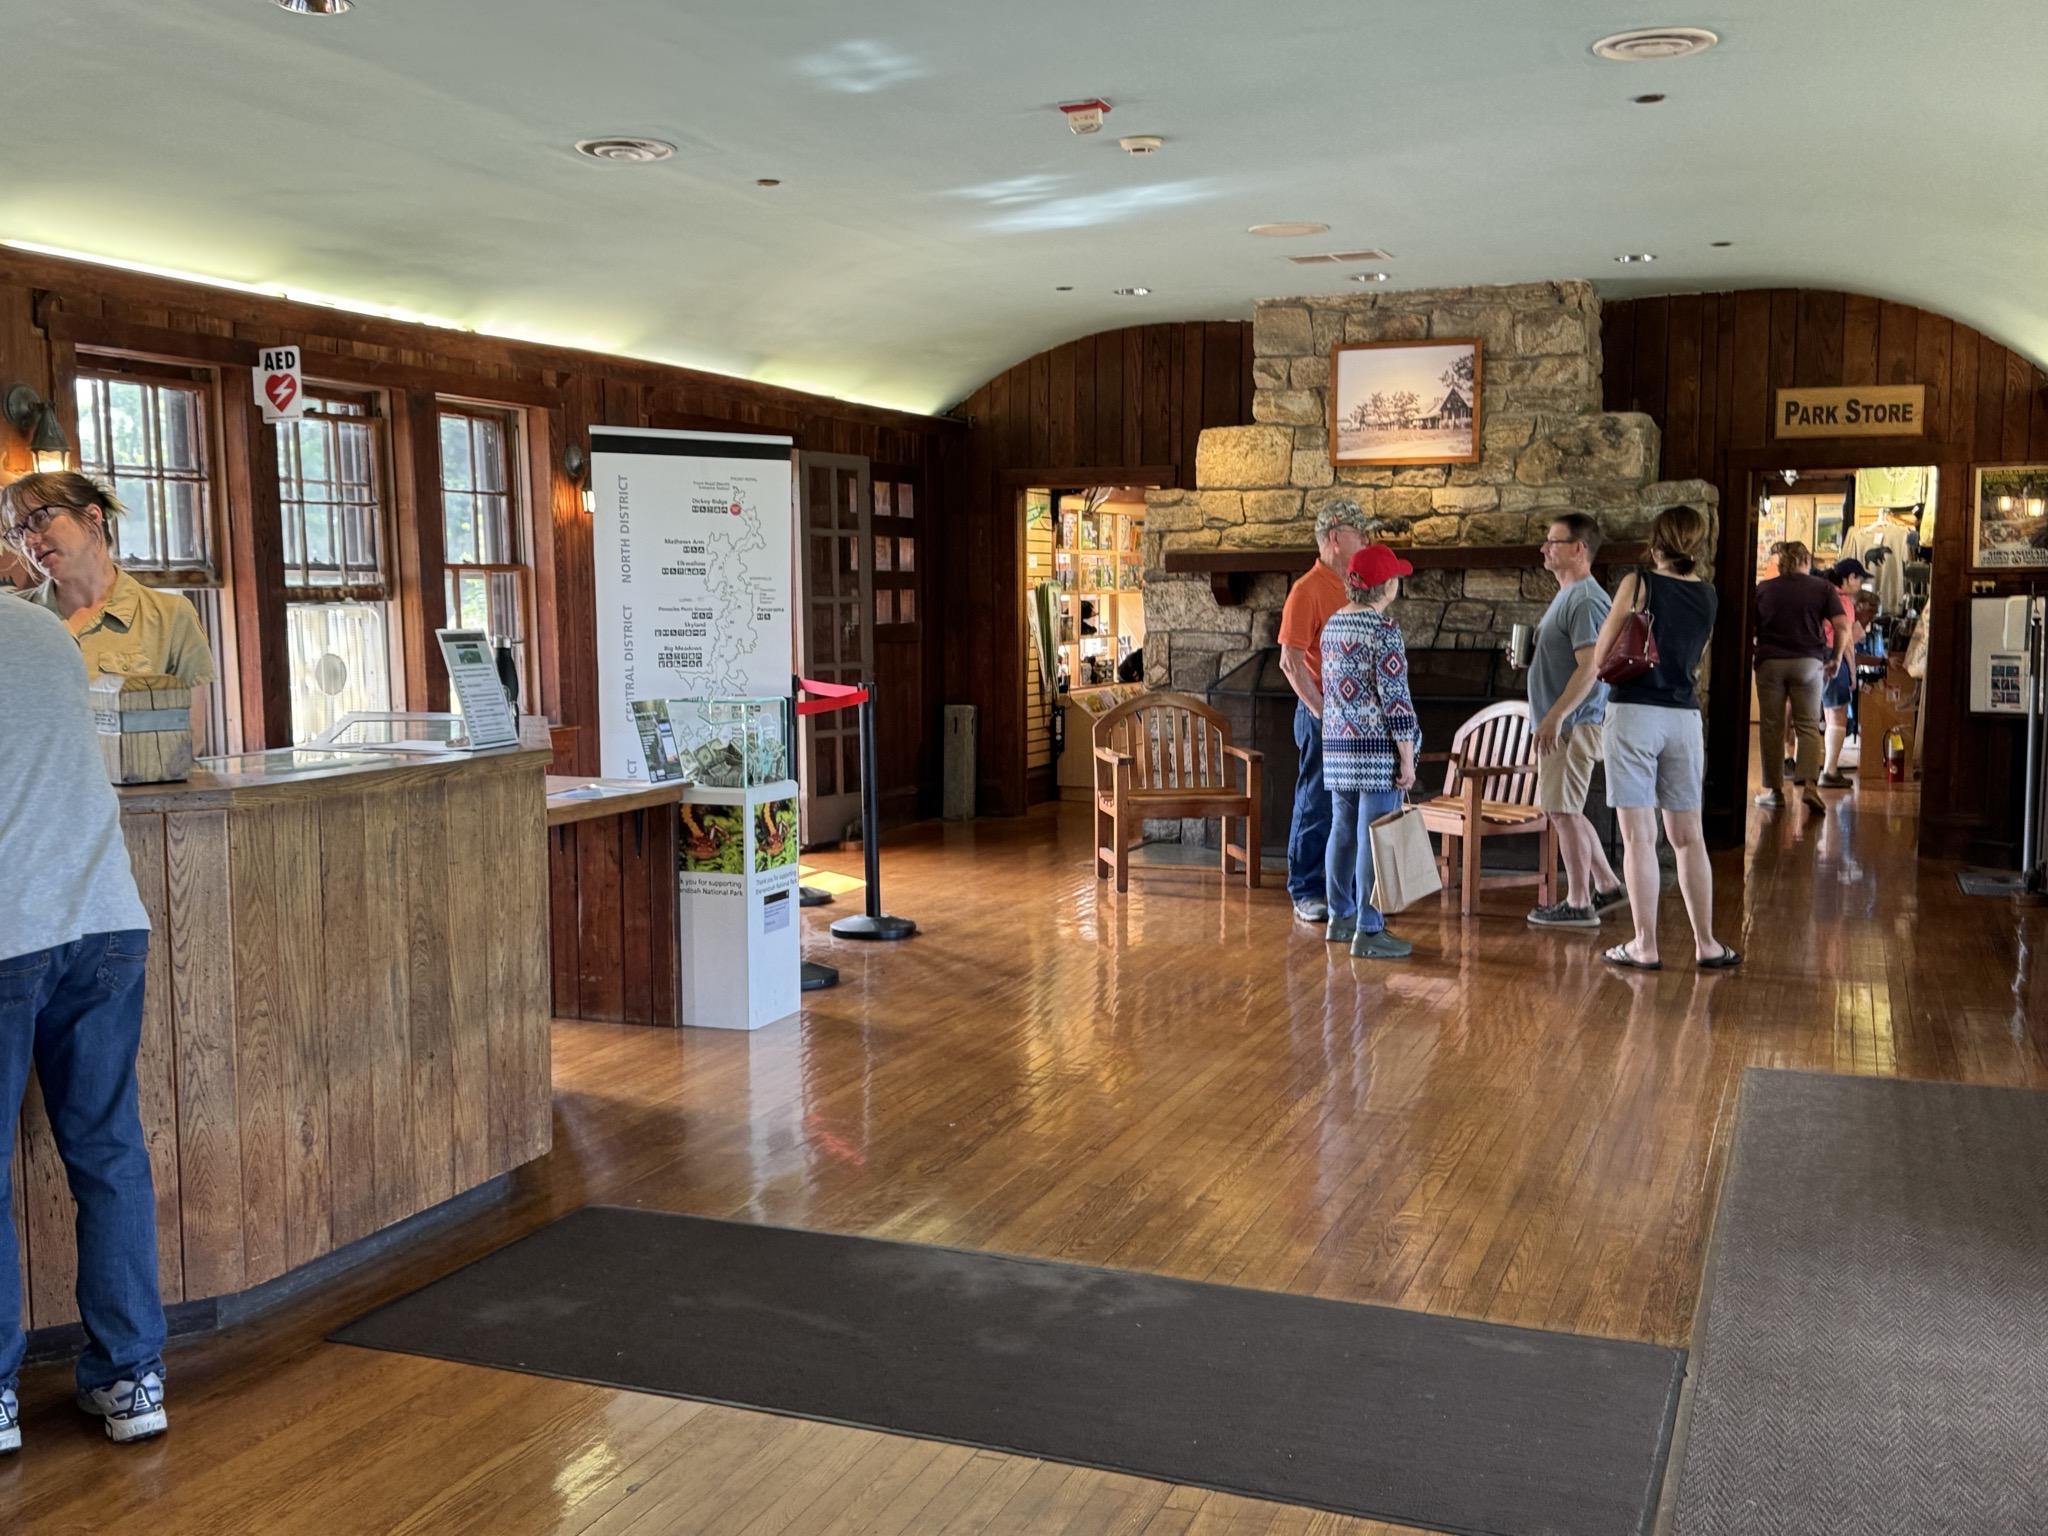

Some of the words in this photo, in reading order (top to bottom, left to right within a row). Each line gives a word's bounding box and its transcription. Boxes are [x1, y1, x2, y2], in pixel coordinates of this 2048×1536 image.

[264, 350, 296, 371] AED
[1785, 401, 1838, 425] PARK
[1845, 398, 1913, 424] STORE
[618, 474, 629, 534] DISTRICT
[620, 538, 631, 583] NORTH
[623, 605, 634, 661] DISTRICT
[684, 621, 706, 629] Skyland
[698, 878, 707, 886] for
[708, 880, 742, 889] supporting
[702, 887, 729, 896] National
[729, 889, 743, 897] Park
